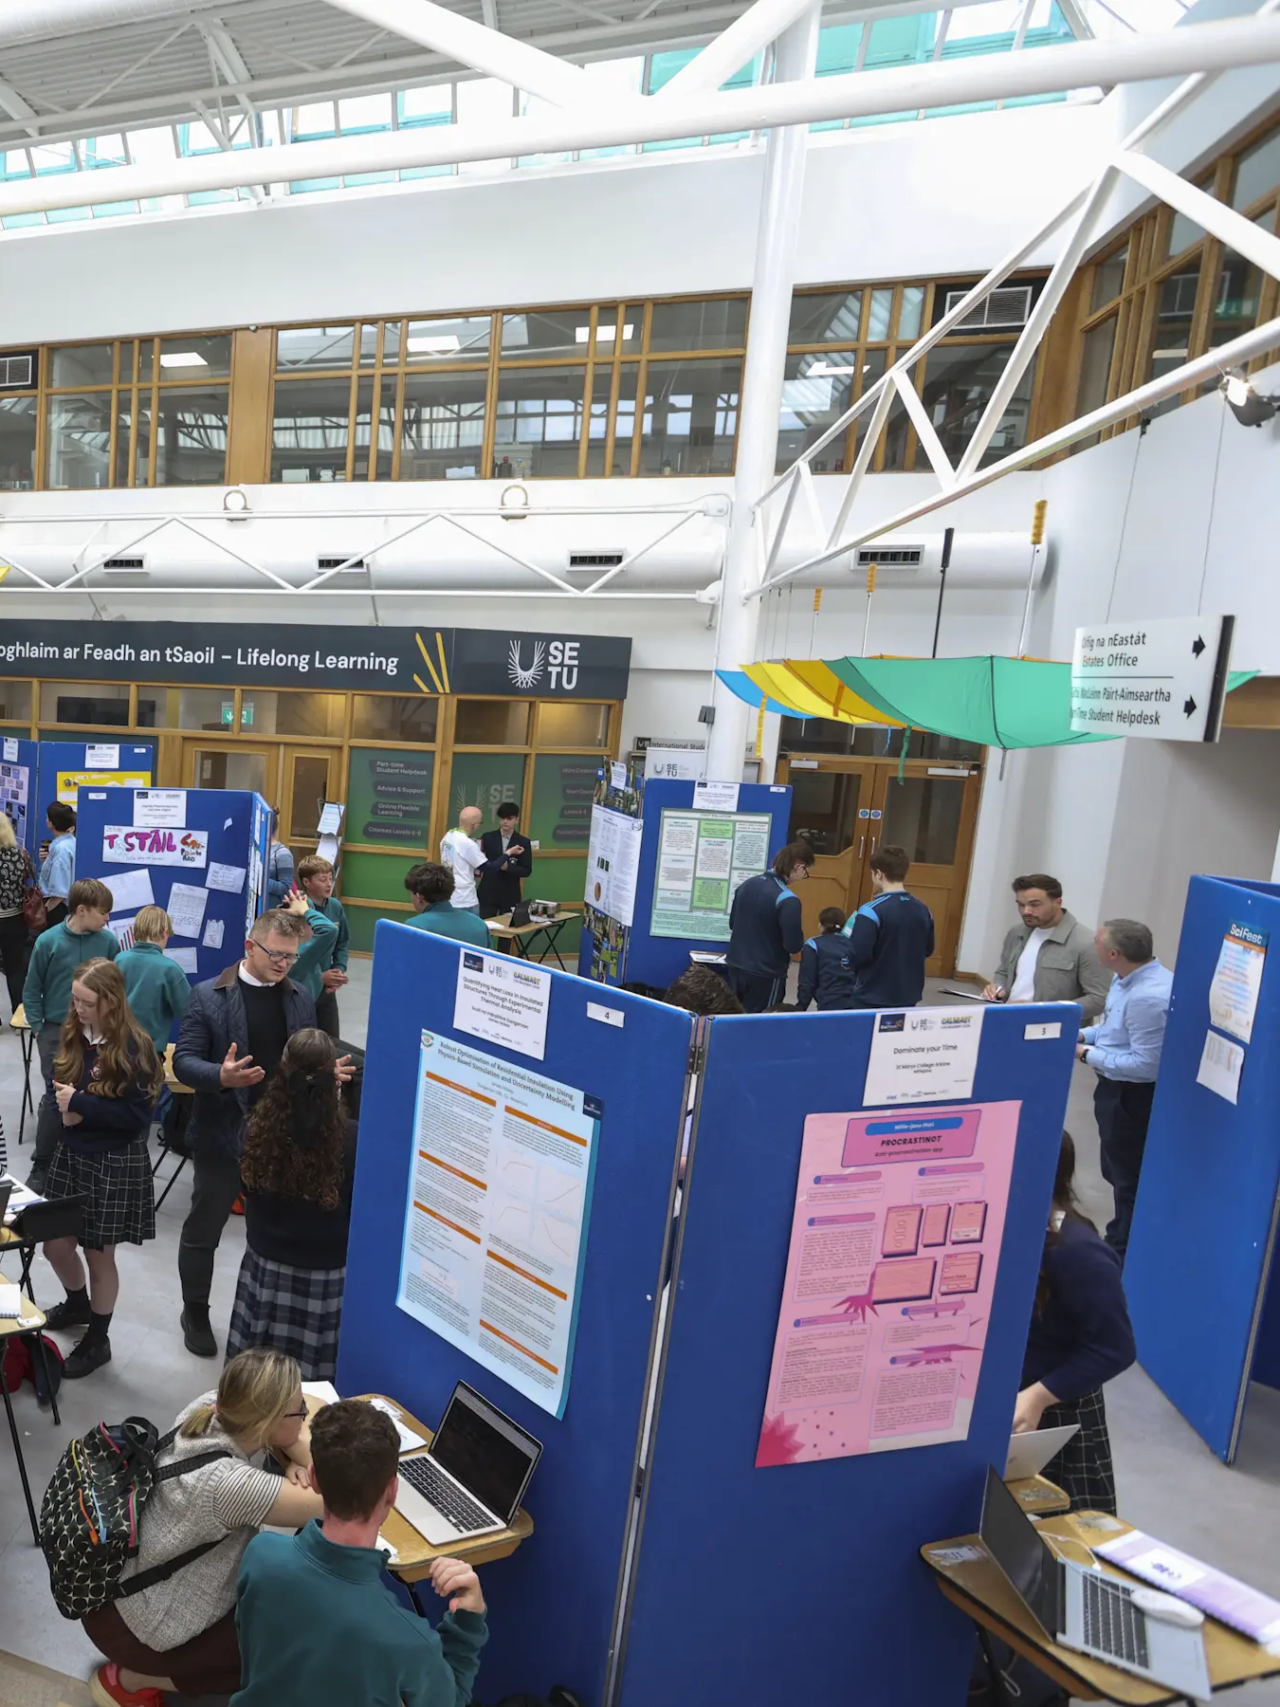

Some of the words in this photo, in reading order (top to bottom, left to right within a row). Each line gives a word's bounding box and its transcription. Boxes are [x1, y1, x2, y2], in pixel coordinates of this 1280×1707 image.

[1108, 631, 1146, 647] nEastát
[63, 647, 80, 660] ar
[84, 644, 135, 661] Feadh
[139, 649, 160, 662] an
[166, 646, 214, 664] tSaoil
[237, 648, 310, 673] Lifelong
[315, 651, 399, 675] Learning
[549, 641, 580, 665] SE
[1107, 653, 1138, 667] Office
[548, 666, 578, 690] TU
[1088, 708, 1114, 722] Student
[1116, 709, 1161, 727] Helpdesk
[400, 768, 427, 776] Helpdesk
[402, 787, 426, 795] Support
[1230, 923, 1263, 945] SciFest
[463, 976, 490, 991] Quantifying
[520, 994, 543, 1007] Insulated
[463, 984, 487, 996] Structures
[488, 992, 508, 1003] Through
[508, 998, 541, 1014] Experimental
[480, 996, 500, 1007] Thermal
[501, 1004, 522, 1015] Analysis
[604, 1012, 610, 1020] 4
[1041, 1027, 1046, 1036] 3
[893, 1046, 925, 1055] Dominate
[926, 1046, 941, 1054] your
[942, 1043, 958, 1051] Time
[437, 1049, 472, 1068] Physics-Based
[472, 1062, 500, 1079] Simulation
[501, 1074, 512, 1084] and
[512, 1078, 545, 1098] Uncertainty
[545, 1092, 576, 1111] Modelling
[440, 1041, 457, 1053] Robust
[457, 1047, 491, 1067] Optimisation
[491, 1061, 497, 1069] of
[497, 1063, 526, 1081] Residential
[527, 1074, 557, 1092] Insulation
[557, 1086, 574, 1101] Using
[880, 1135, 942, 1147] PROCRASTINOT
